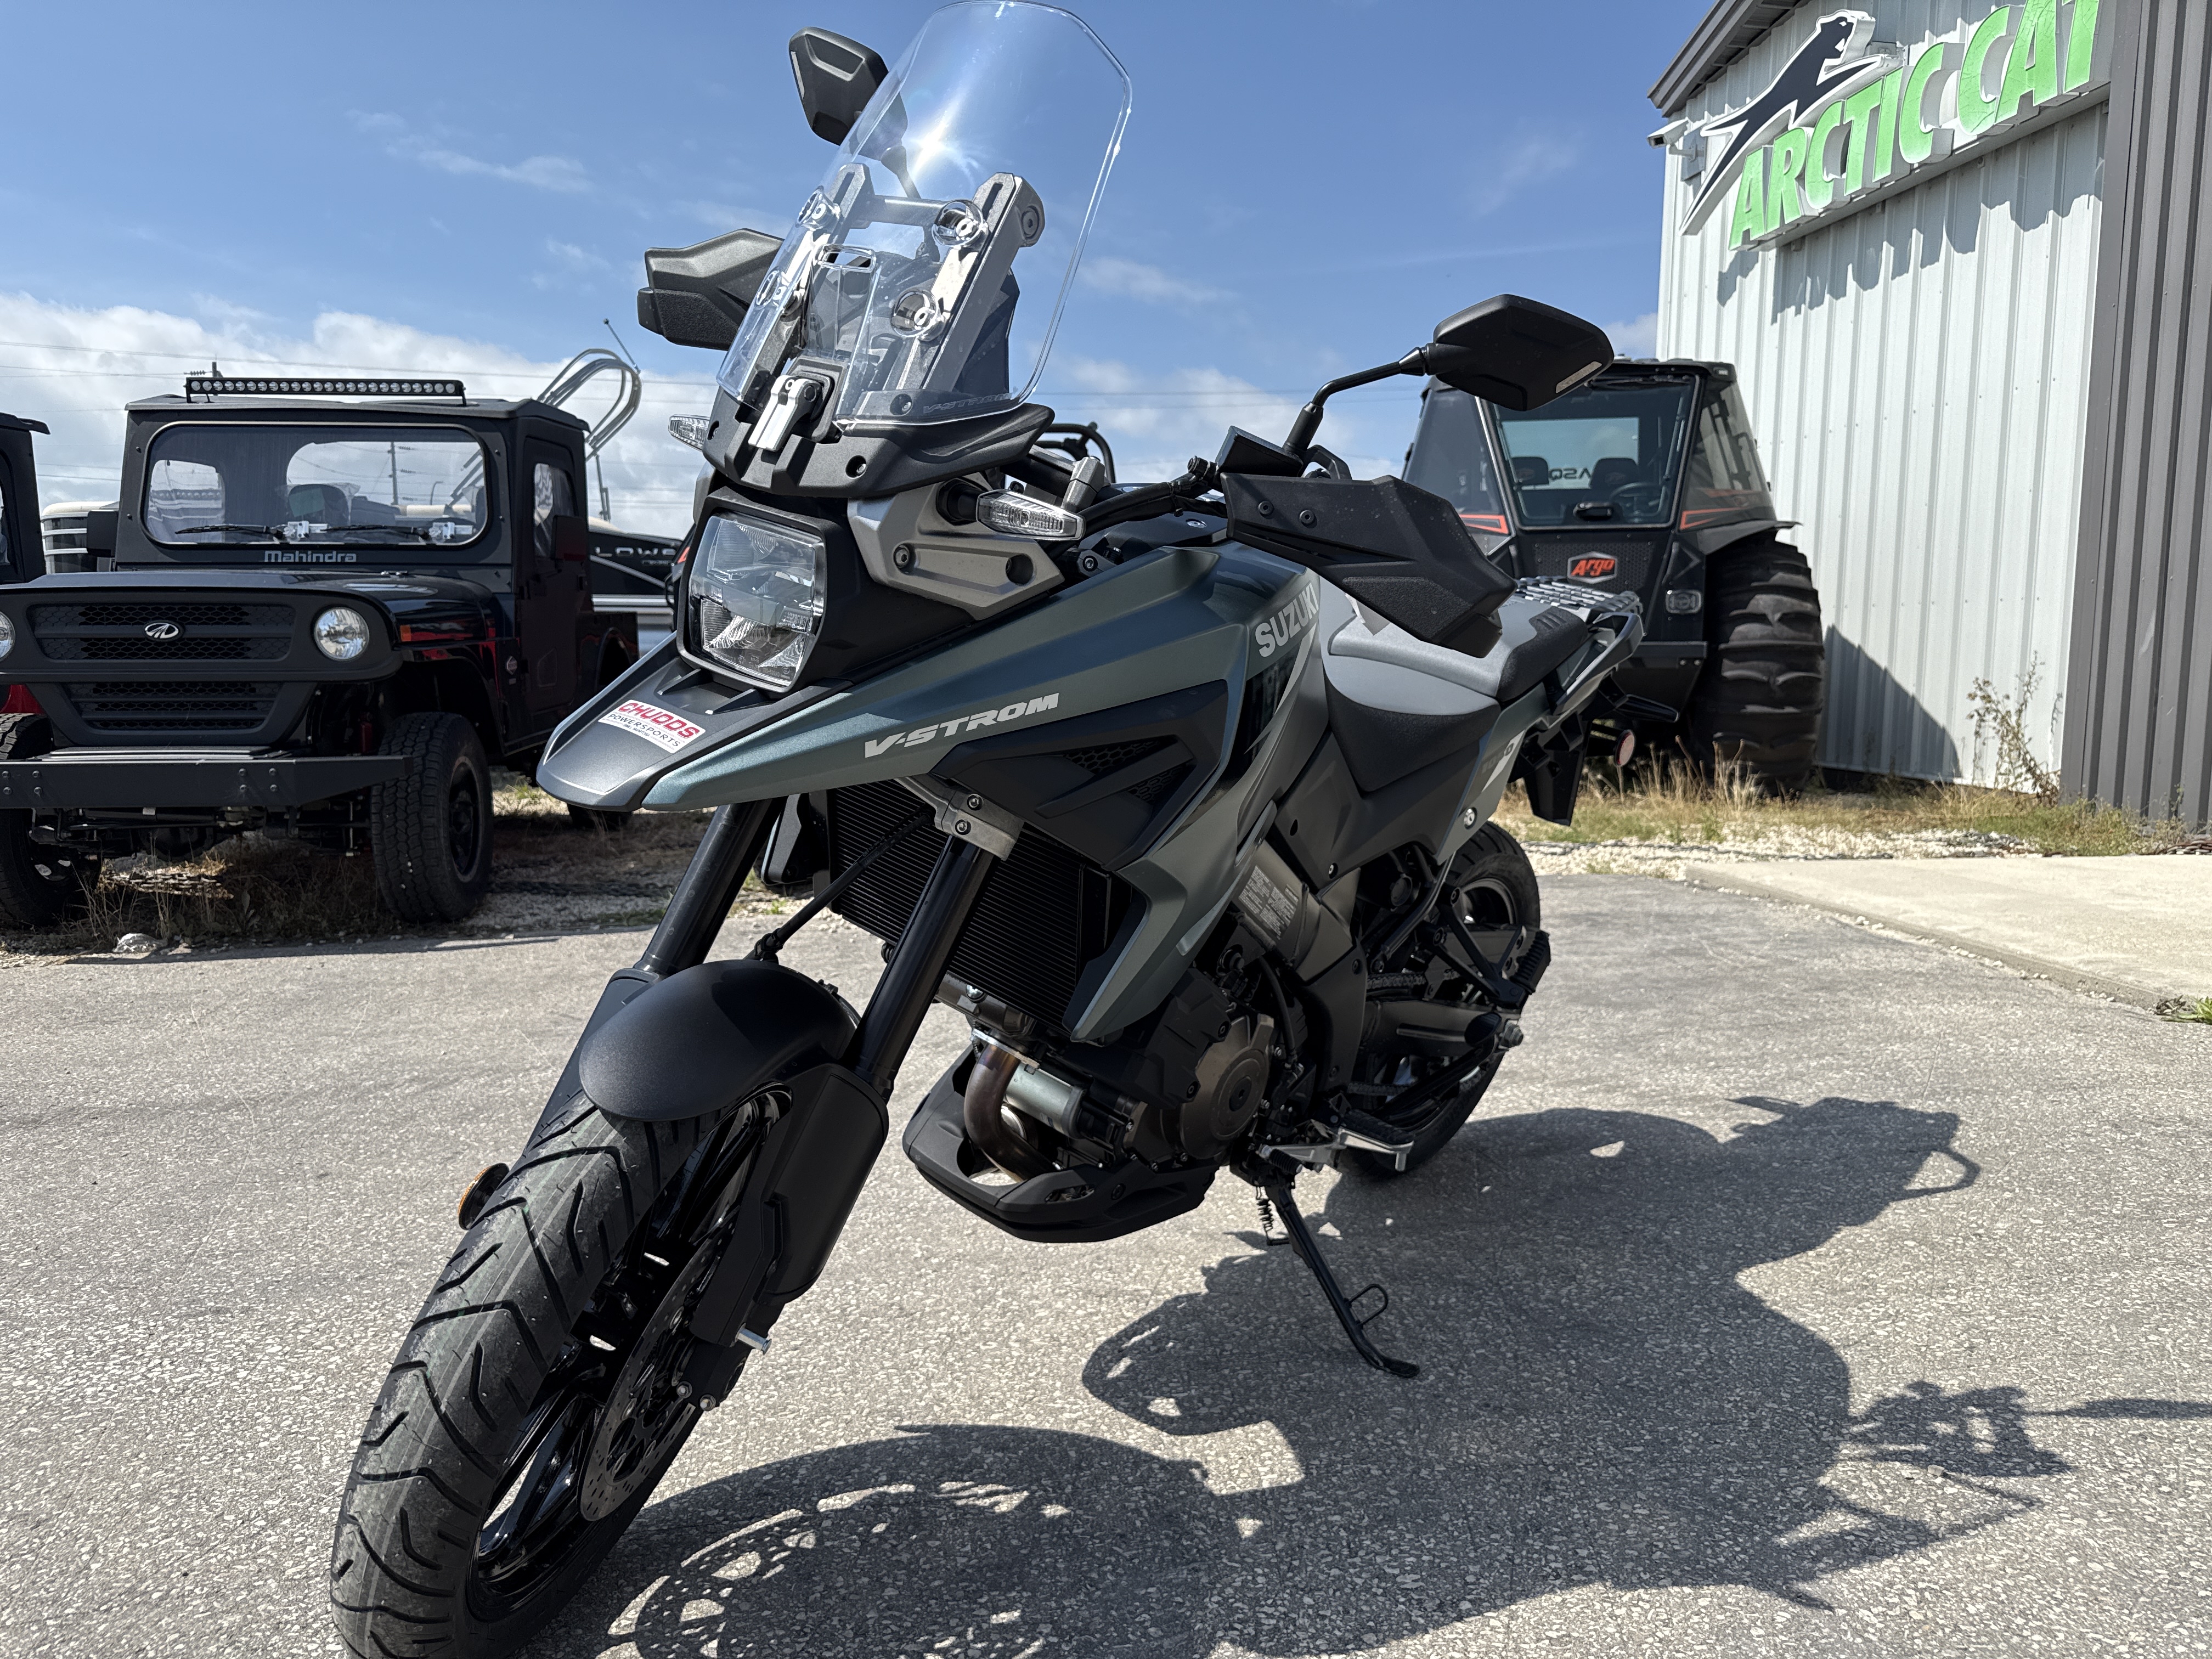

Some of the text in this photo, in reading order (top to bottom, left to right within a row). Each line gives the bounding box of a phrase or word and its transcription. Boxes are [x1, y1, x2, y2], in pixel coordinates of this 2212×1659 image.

[1729, 0, 2100, 250] ARCTIC CAT
[923, 393, 1012, 414] V-STROM
[264, 550, 357, 562] Mahindra
[1571, 558, 1616, 577] Argo
[1255, 582, 1319, 657] SUZUKI
[607, 714, 681, 747] POWERSPORTS
[618, 702, 701, 738] CHUDDS
[865, 692, 1059, 758] V-STROM
